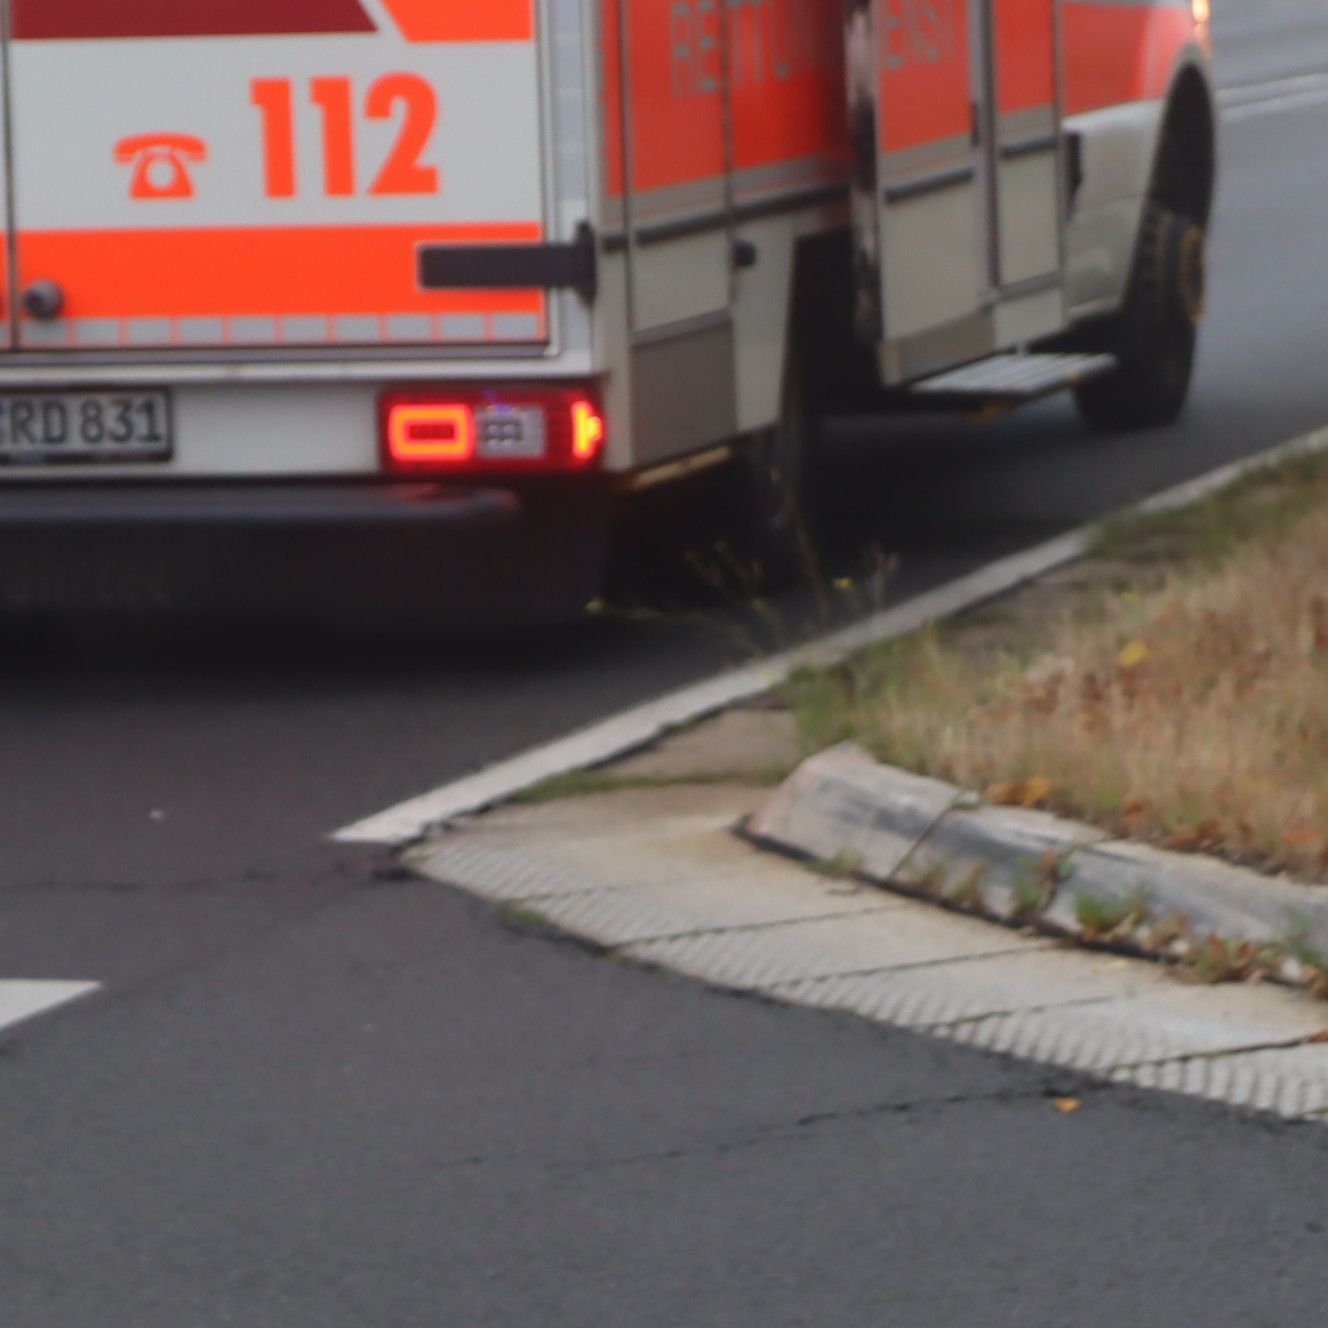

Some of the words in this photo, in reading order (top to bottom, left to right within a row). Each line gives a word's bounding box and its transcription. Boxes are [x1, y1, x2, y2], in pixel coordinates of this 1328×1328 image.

[248, 70, 440, 199] 112
[10, 400, 69, 445] RD
[80, 398, 162, 444] 831
